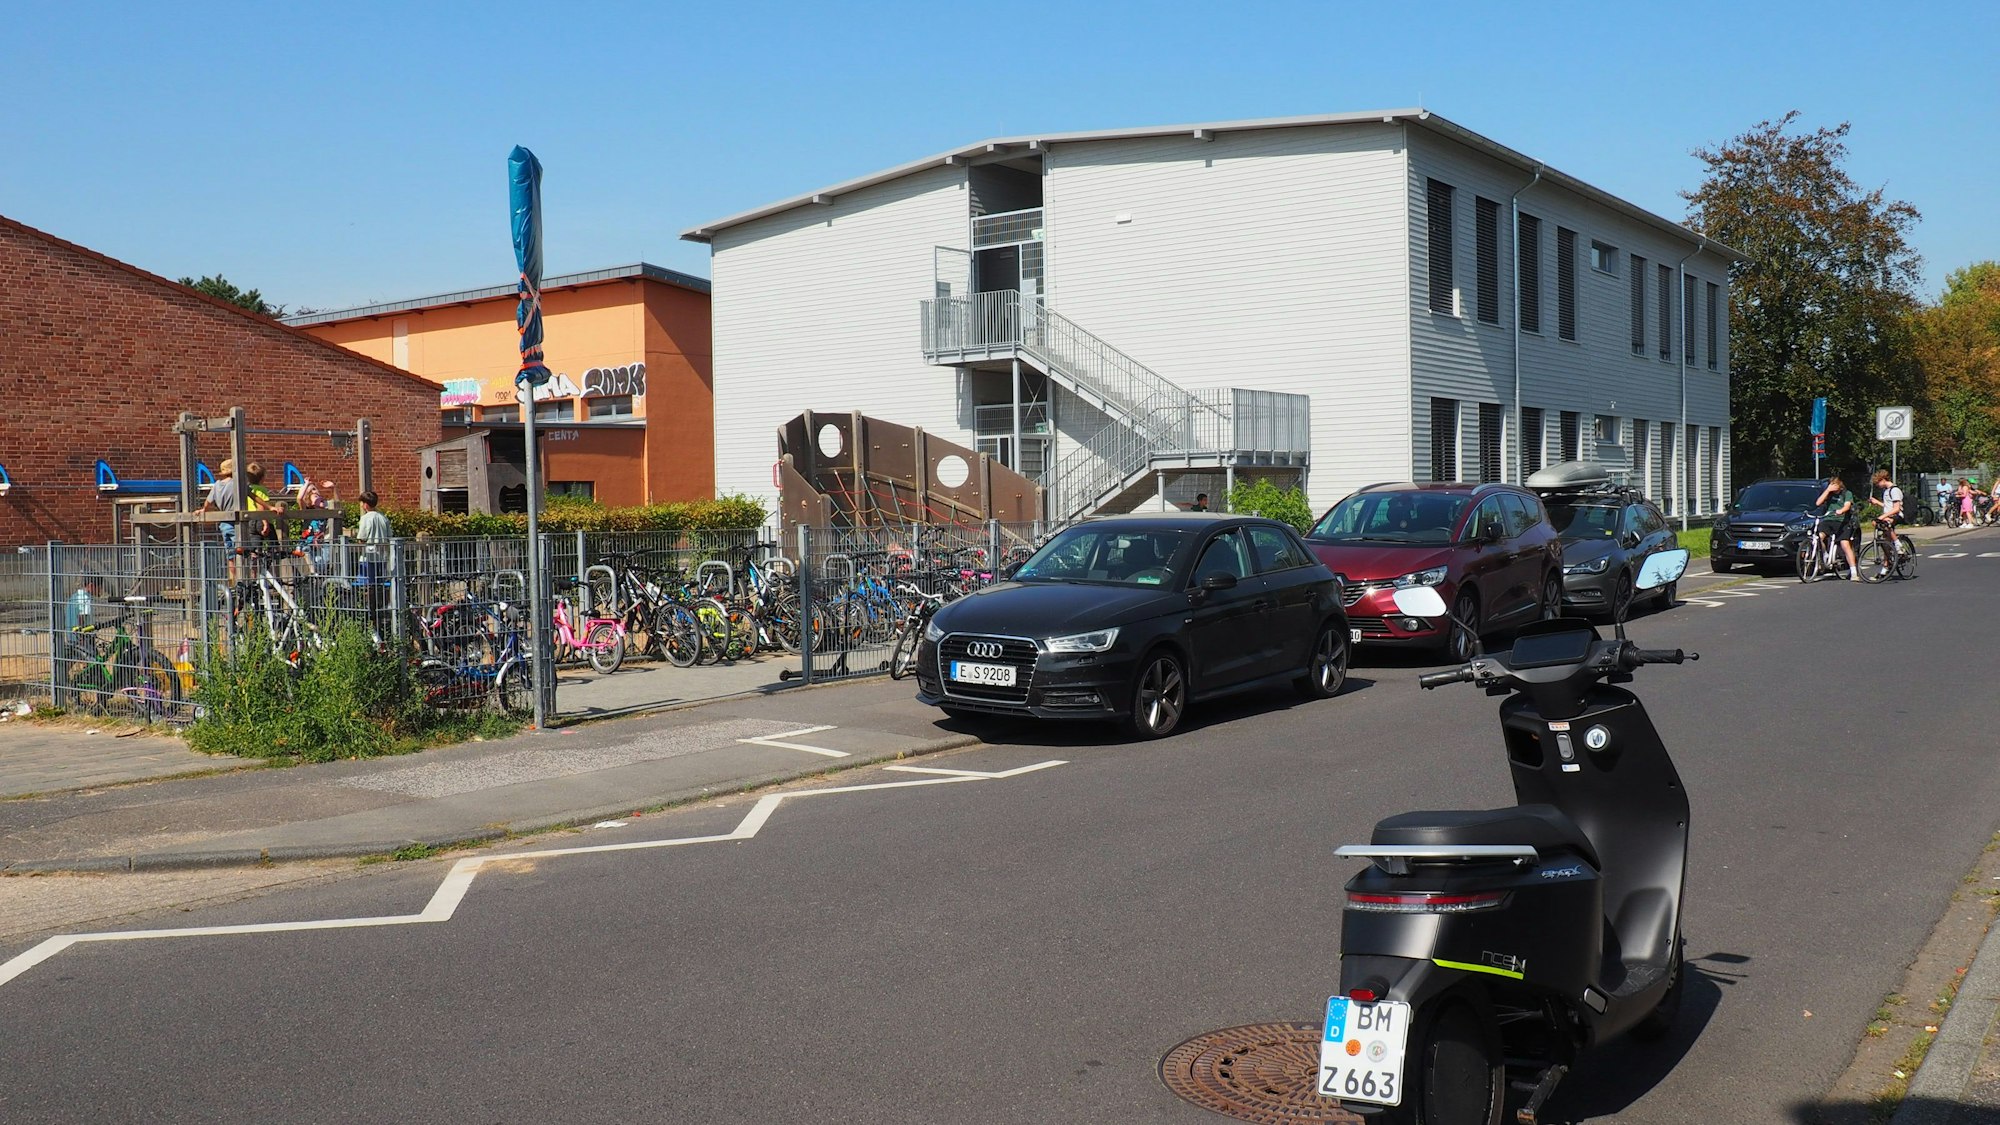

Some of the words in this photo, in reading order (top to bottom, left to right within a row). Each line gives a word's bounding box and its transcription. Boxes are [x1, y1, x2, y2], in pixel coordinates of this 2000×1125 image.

[1888, 416, 1901, 426] 30
[960, 665, 967, 678] E
[973, 666, 981, 679] S
[983, 667, 1011, 681] 9208
[1357, 1004, 1392, 1032] BM
[1330, 1026, 1340, 1038] D
[1322, 1066, 1338, 1093] Z
[1344, 1068, 1395, 1099] 663
